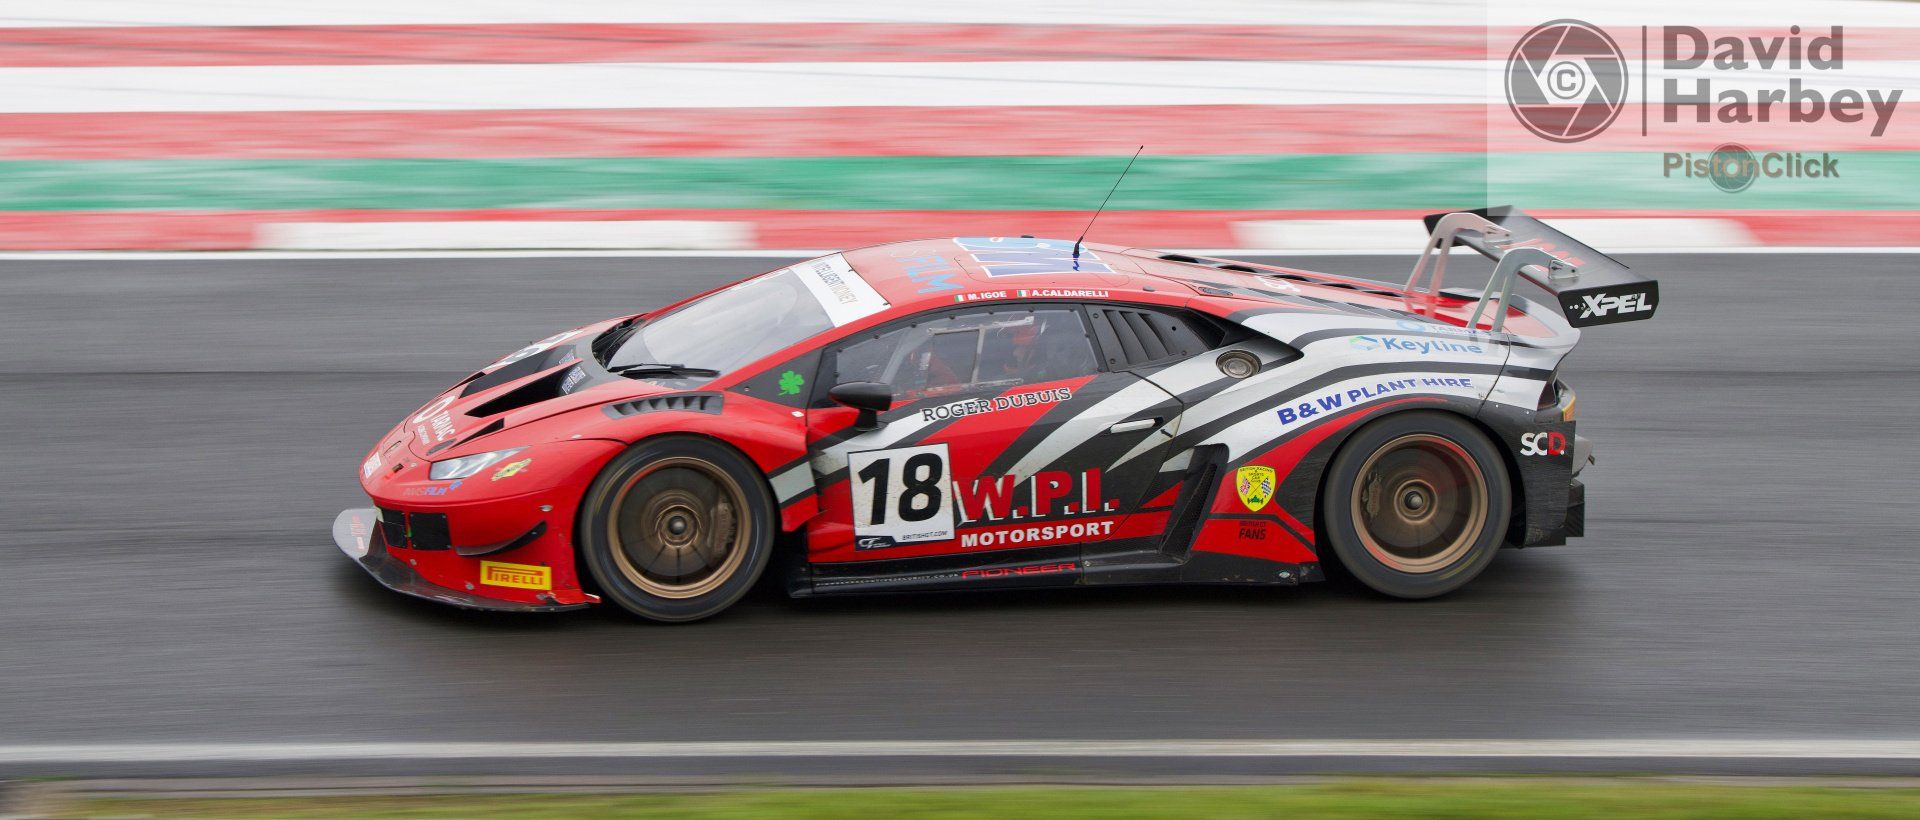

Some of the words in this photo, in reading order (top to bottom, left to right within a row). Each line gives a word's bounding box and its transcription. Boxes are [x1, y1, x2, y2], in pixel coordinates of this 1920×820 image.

[1031, 289, 1109, 298] A.CALDARELLI
[1579, 292, 1652, 319] XPEL
[1381, 336, 1483, 355] Keyline
[922, 398, 992, 422] ROGER
[997, 387, 1072, 410] DUBUIS
[1276, 392, 1343, 426] B&W
[1347, 378, 1418, 404] PLANT
[1421, 377, 1472, 388] HIRE
[857, 453, 944, 526] 18
[953, 467, 1119, 527] W.P.I.
[961, 520, 1115, 548] MOTORSPORT
[487, 565, 545, 586] PIRELLI
[961, 562, 1076, 580] PIONEER
